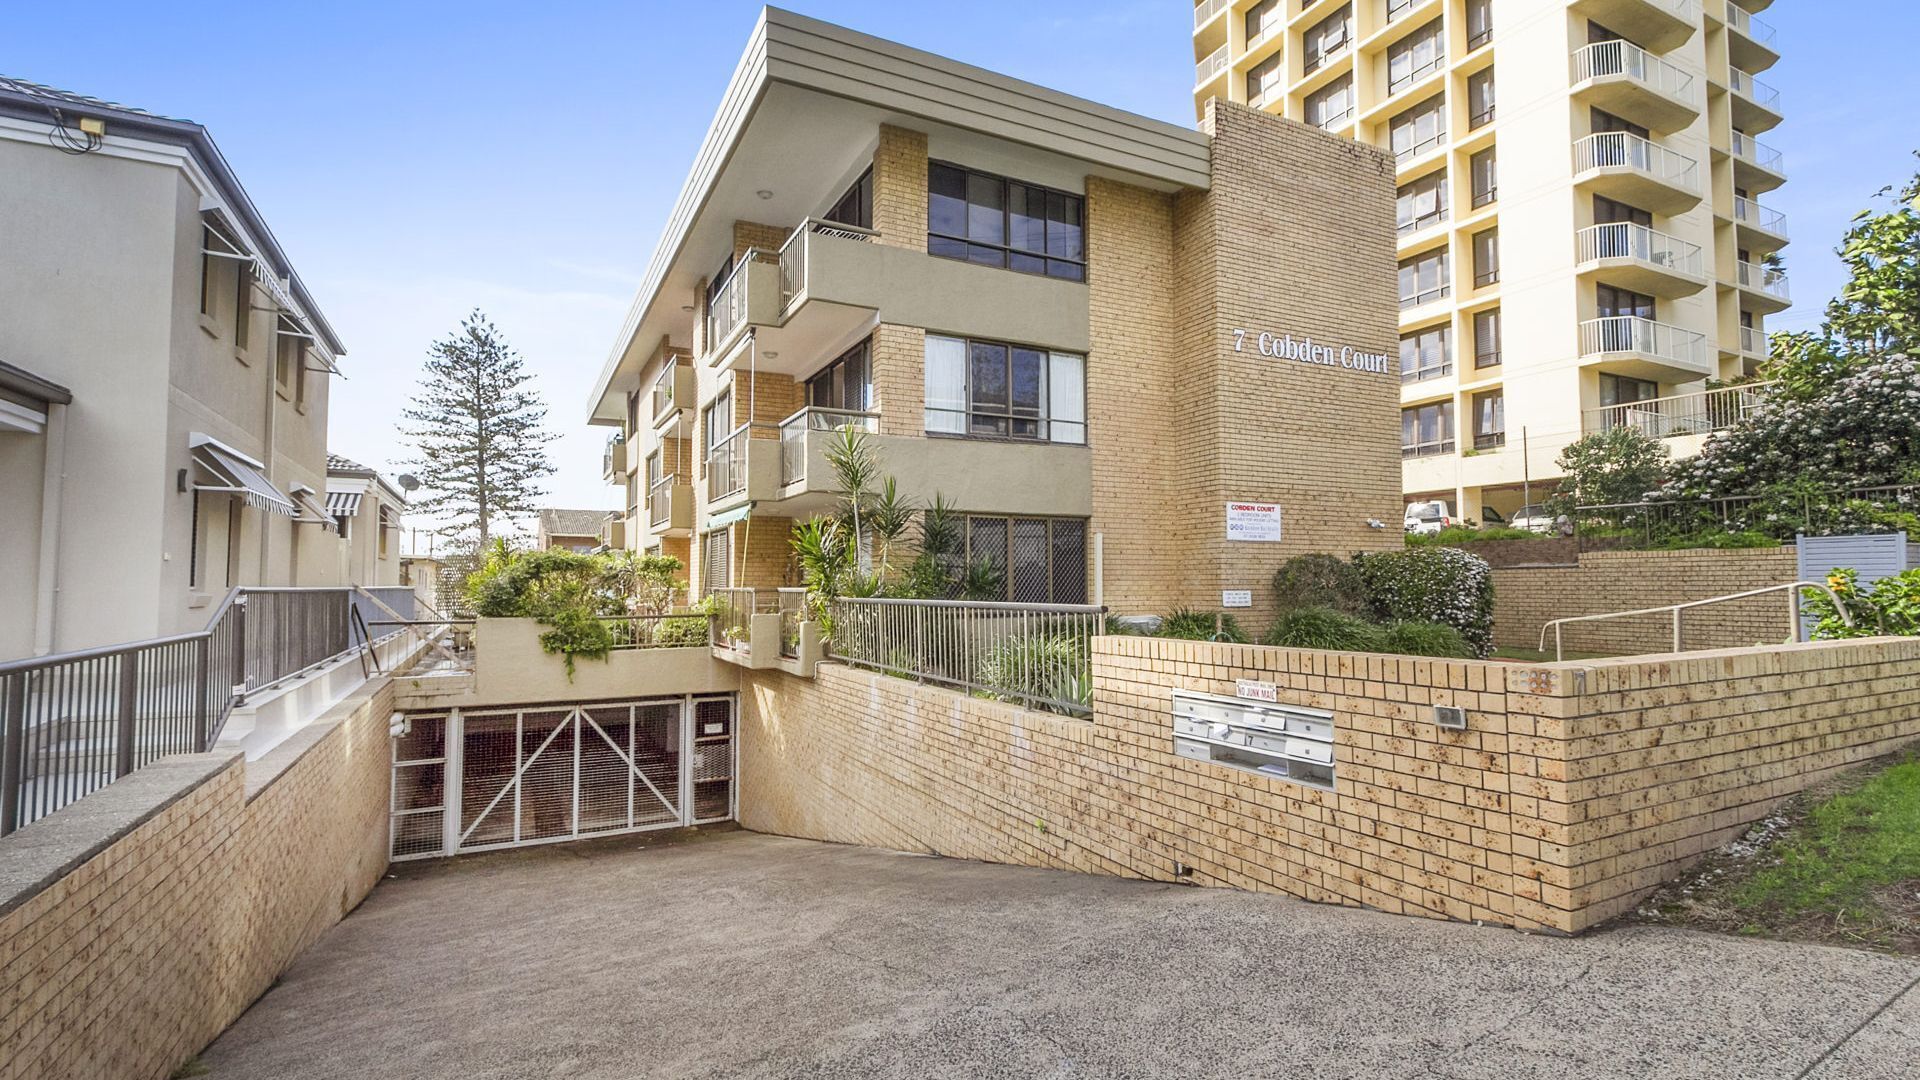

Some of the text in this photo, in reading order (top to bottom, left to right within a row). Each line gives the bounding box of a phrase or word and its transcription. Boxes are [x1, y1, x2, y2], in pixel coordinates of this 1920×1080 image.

[1233, 329, 1389, 374] 7 Cobden Court
[1238, 686, 1275, 700] NO JUNK MAIL
[1247, 735, 1254, 746] 7
